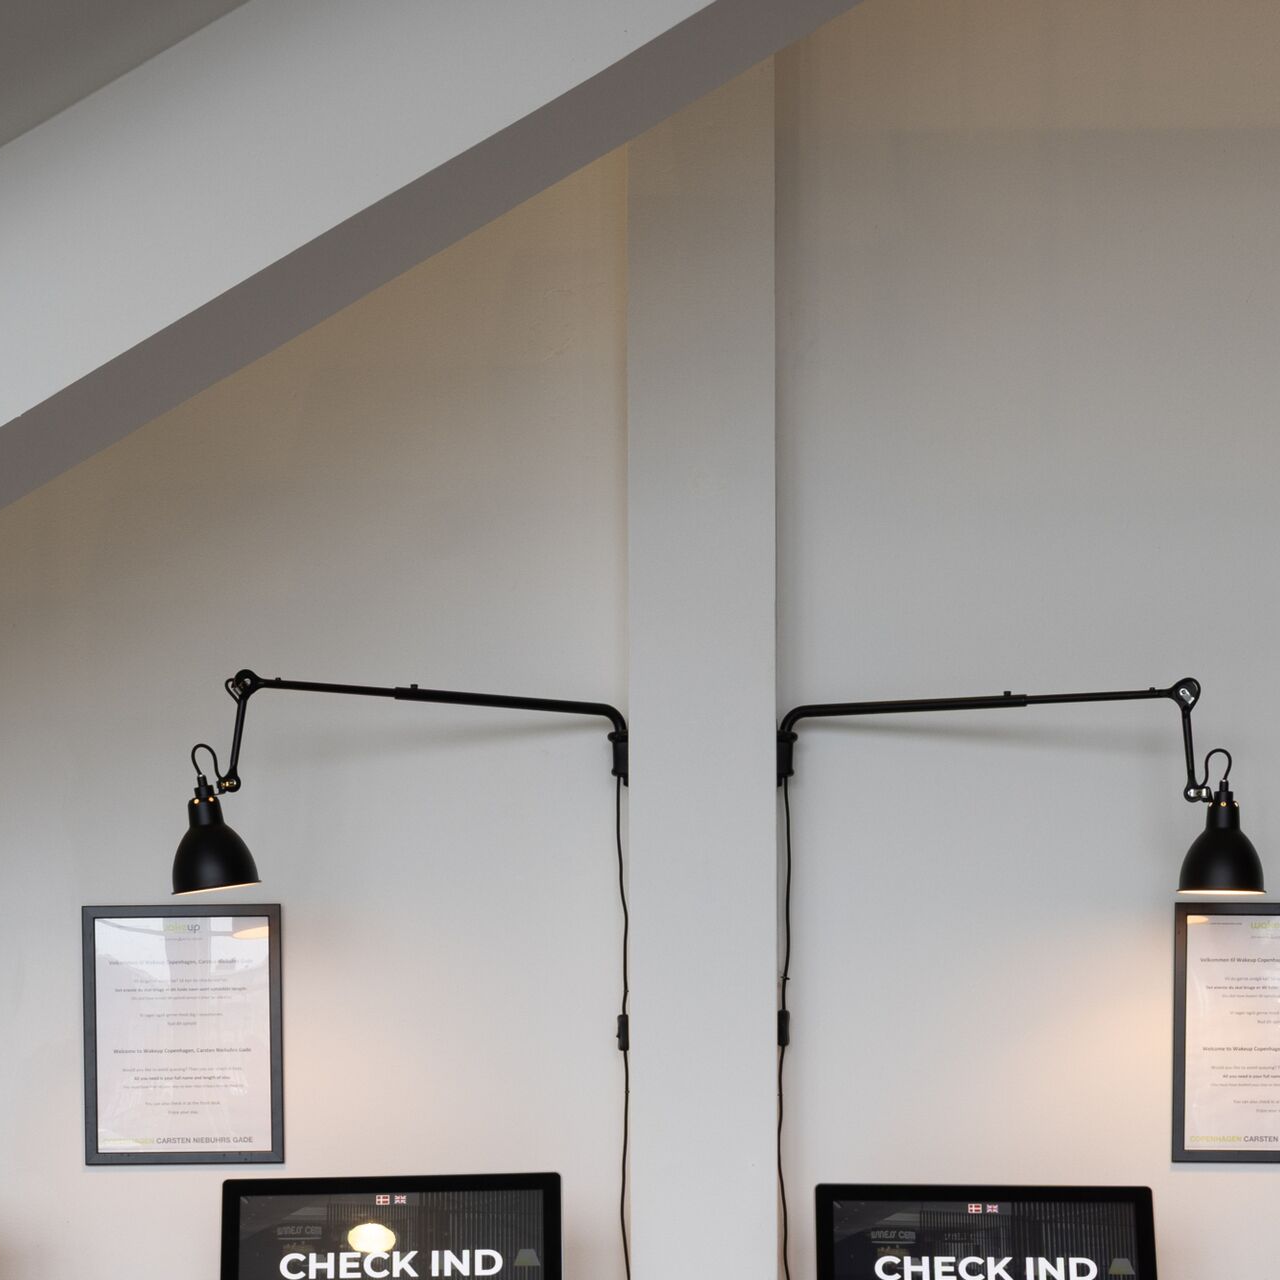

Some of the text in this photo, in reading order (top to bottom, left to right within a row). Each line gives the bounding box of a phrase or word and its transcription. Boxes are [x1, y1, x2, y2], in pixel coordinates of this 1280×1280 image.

[1243, 1135, 1279, 1143] CARSTEN
[279, 1248, 504, 1280] CHECK IND
